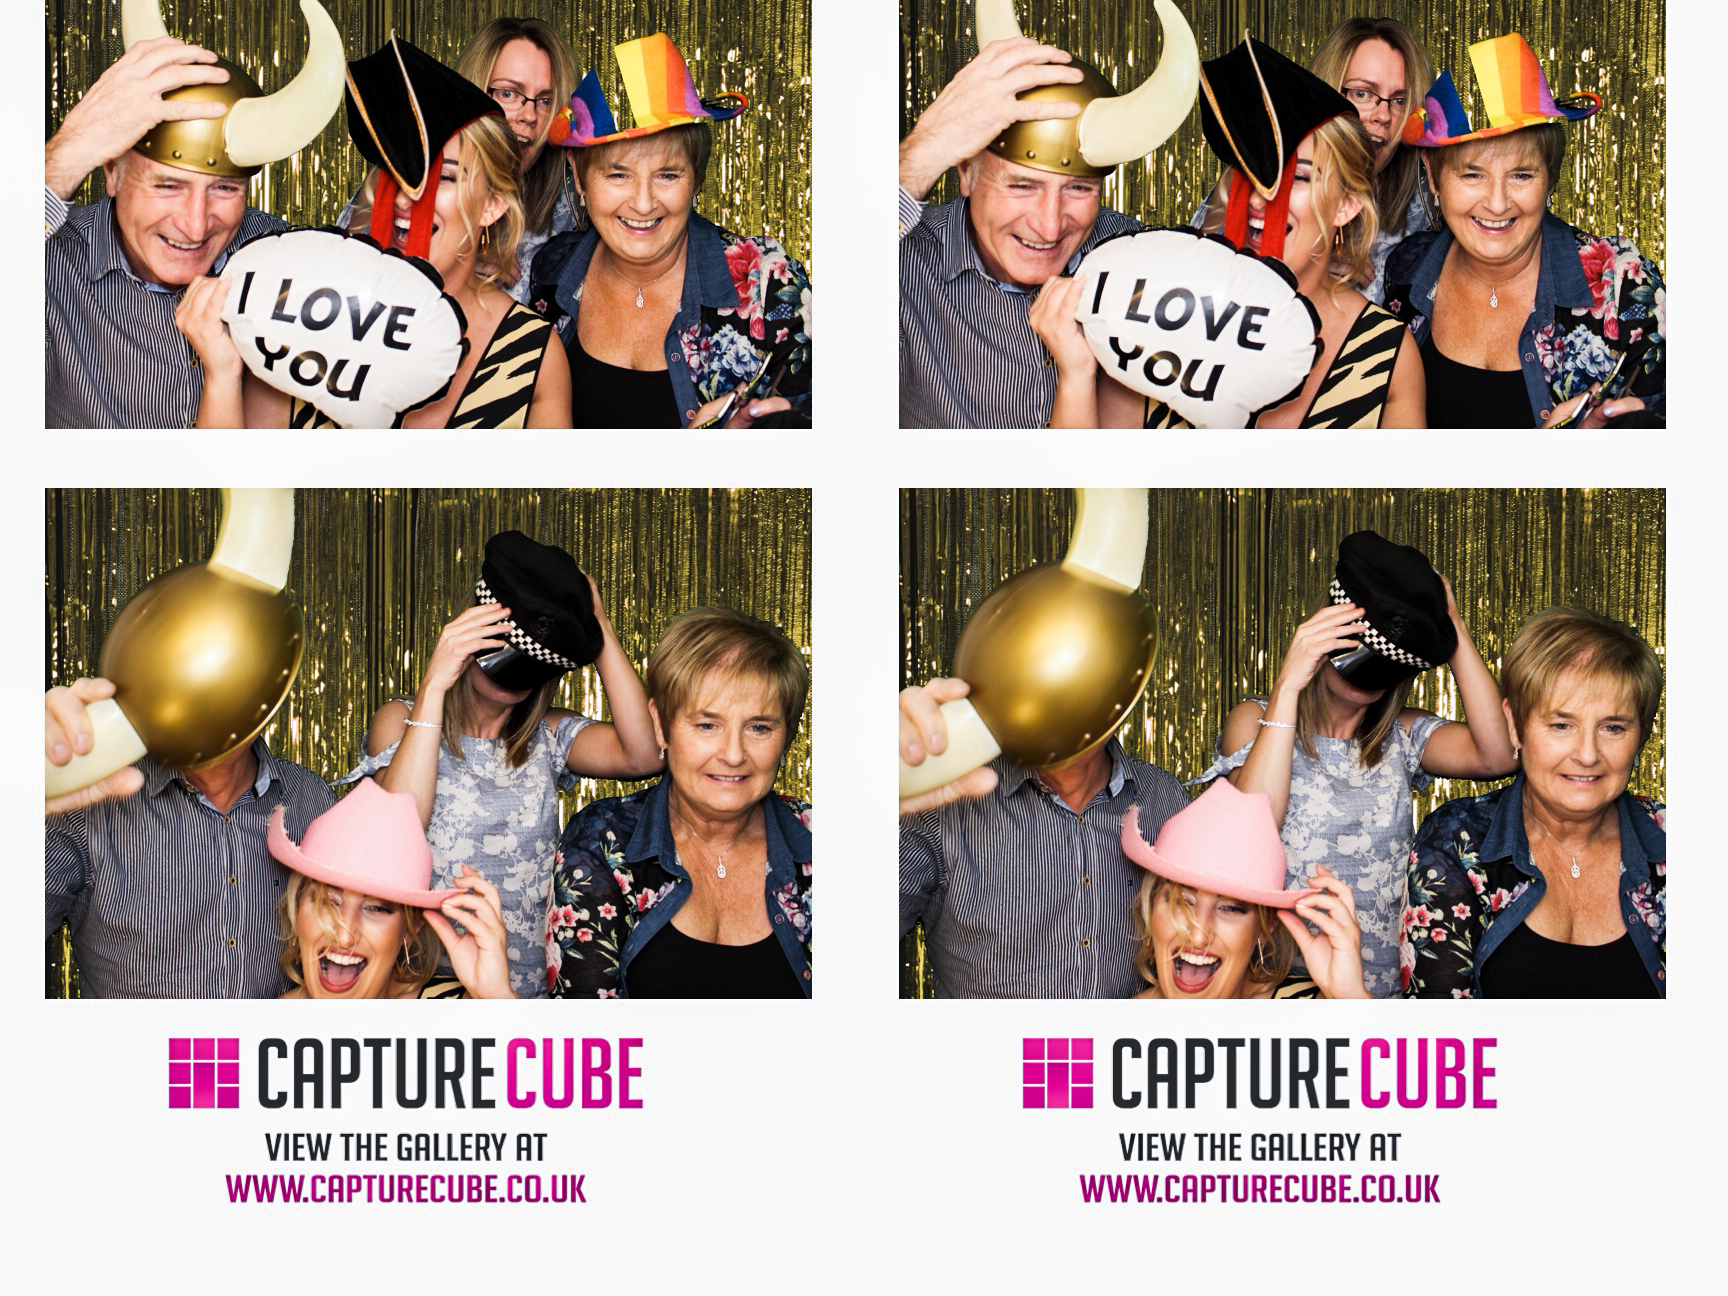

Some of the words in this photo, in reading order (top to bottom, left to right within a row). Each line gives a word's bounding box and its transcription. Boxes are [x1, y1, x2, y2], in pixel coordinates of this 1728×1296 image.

[237, 271, 256, 315] I
[270, 278, 416, 351] LOVE
[1091, 271, 1110, 315] I
[1124, 278, 1270, 351] LOVE
[255, 336, 371, 402] YOU
[1109, 336, 1225, 402] YOU
